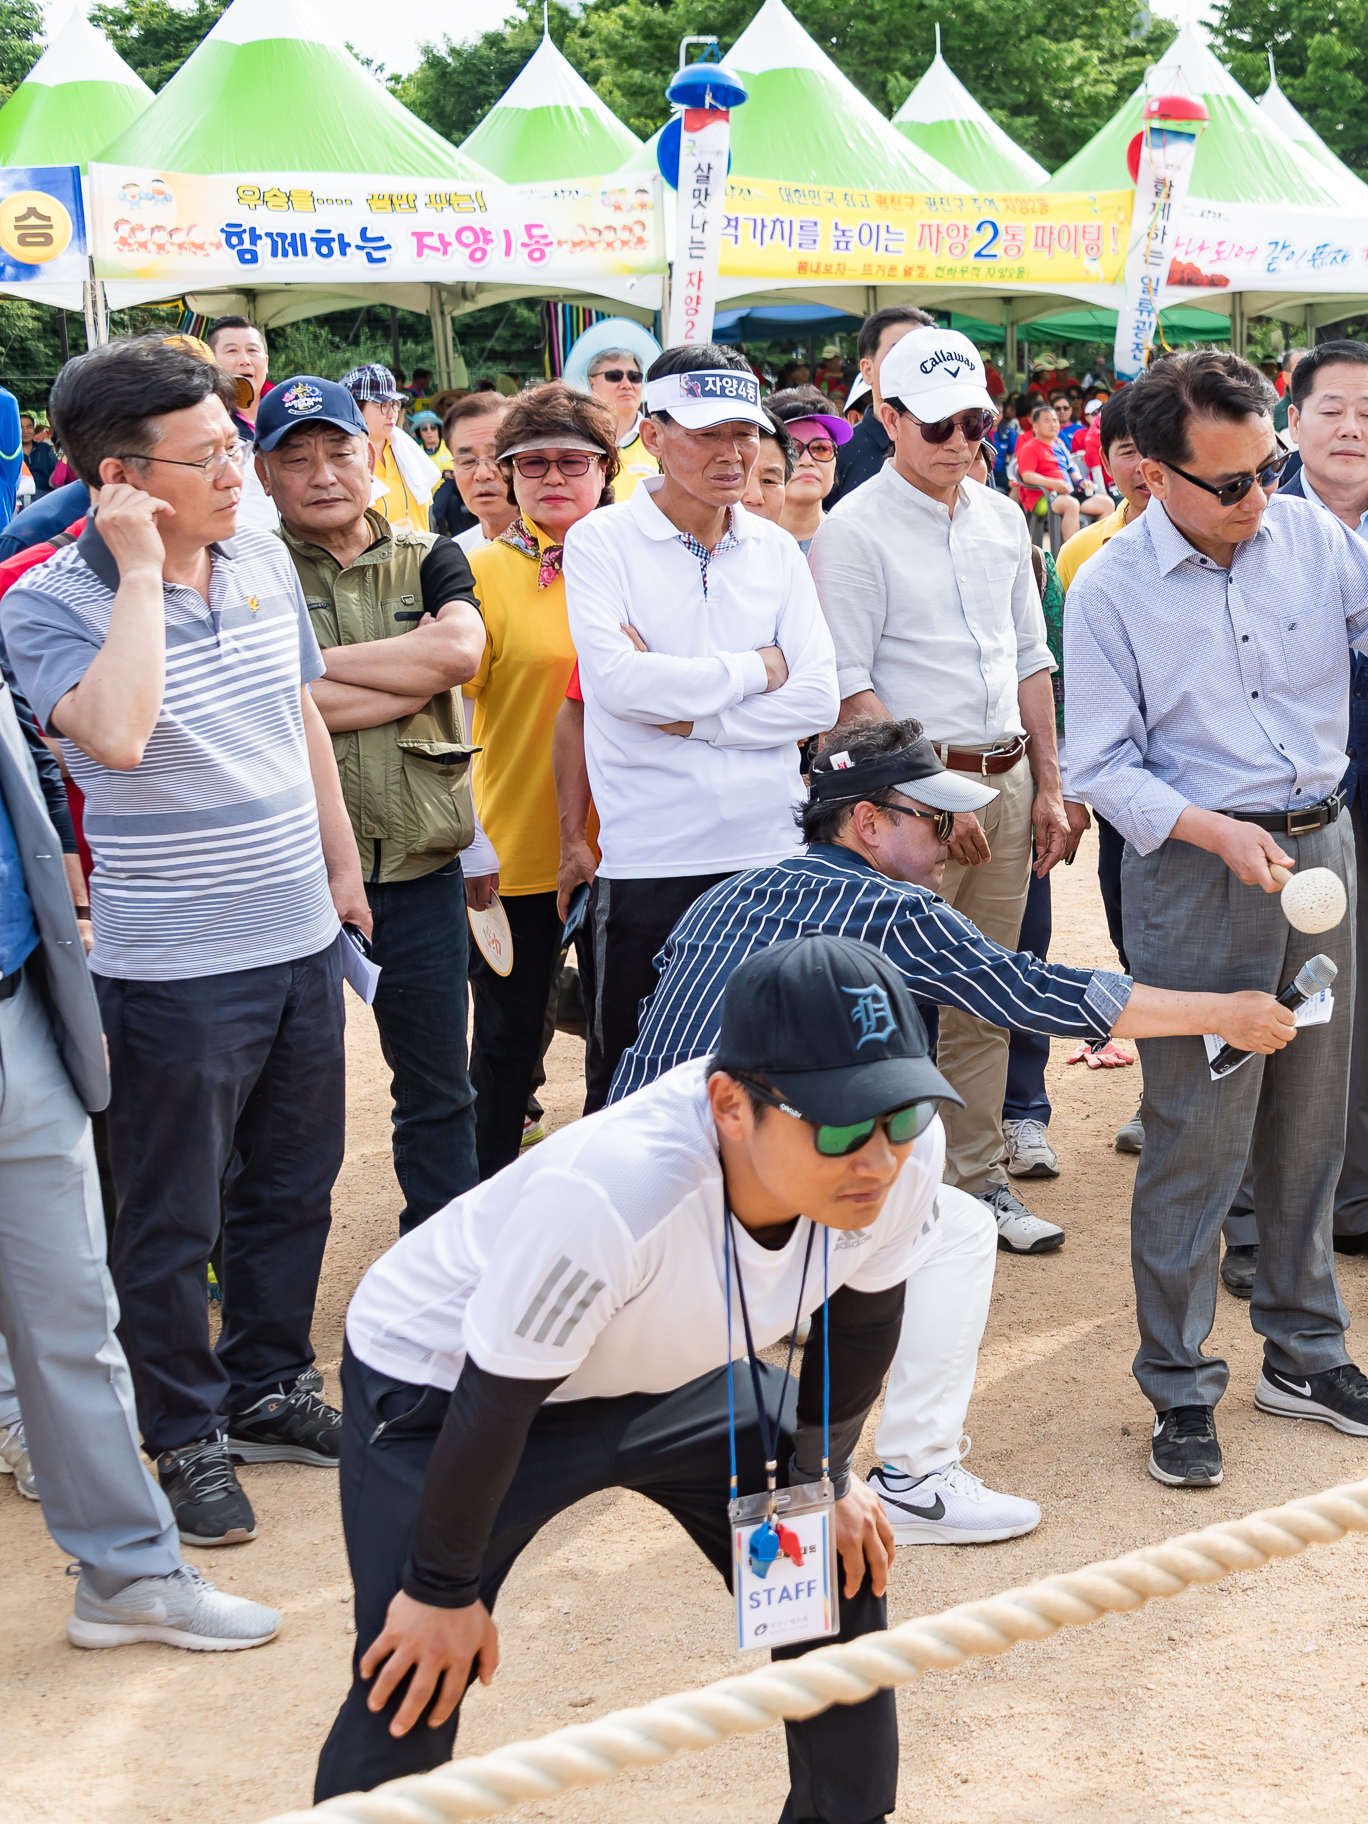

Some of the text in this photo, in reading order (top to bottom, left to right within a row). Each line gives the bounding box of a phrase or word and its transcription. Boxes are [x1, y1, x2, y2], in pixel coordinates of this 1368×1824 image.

[688, 162, 713, 260] 살맛나는
[778, 186, 838, 208] 대한민국
[843, 192, 871, 209] 최고
[925, 196, 964, 213] 광진구
[1001, 197, 1050, 216] 자양2동
[14, 206, 54, 247] 승
[220, 222, 392, 265] 함께하는
[832, 220, 905, 254] 높이는
[917, 219, 1026, 260] 자양2동
[861, 262, 899, 278] 뜨거운
[684, 270, 704, 347] 자양2
[920, 349, 976, 375] Callaway
[704, 376, 756, 403] 자양4동
[840, 983, 898, 1050] D
[749, 1578, 818, 1610] STAFF
